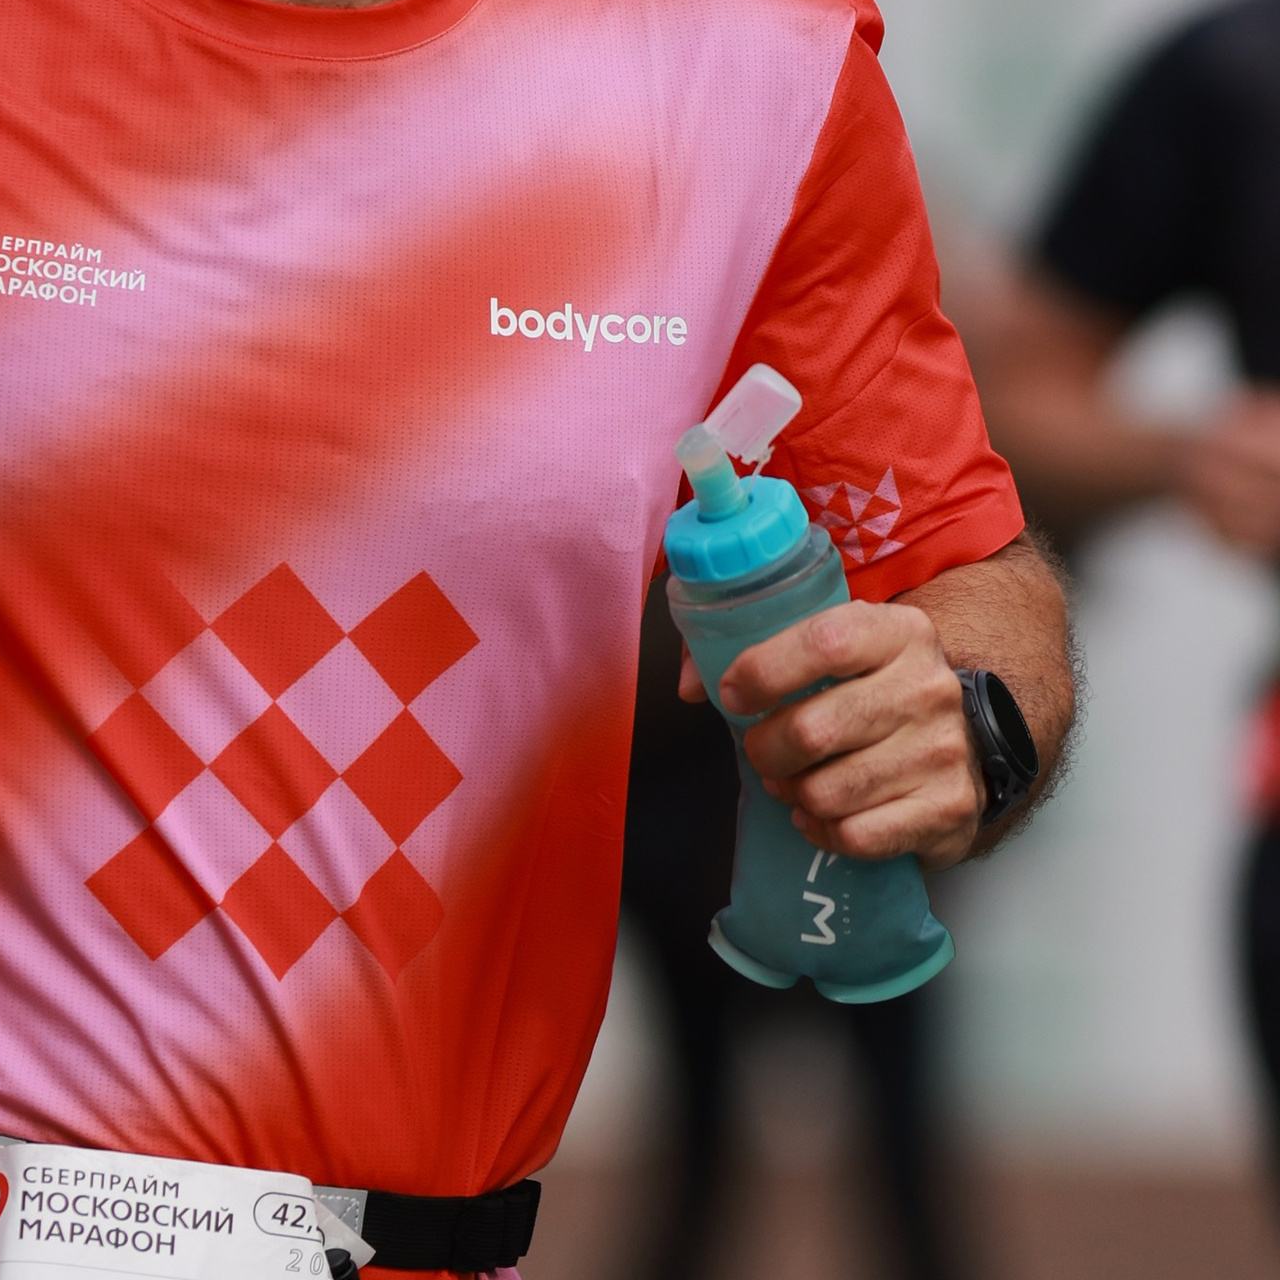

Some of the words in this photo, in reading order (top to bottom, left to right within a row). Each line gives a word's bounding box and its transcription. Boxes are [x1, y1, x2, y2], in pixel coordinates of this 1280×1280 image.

[490, 297, 688, 352] bodycore
[22, 1166, 180, 1199] СБЕРПРАЙМ
[20, 1190, 234, 1235] МОСКОВСКИЙ
[271, 1202, 313, 1233] 42,
[18, 1218, 176, 1256] МАРАФОН
[285, 1248, 326, 1276] 20
